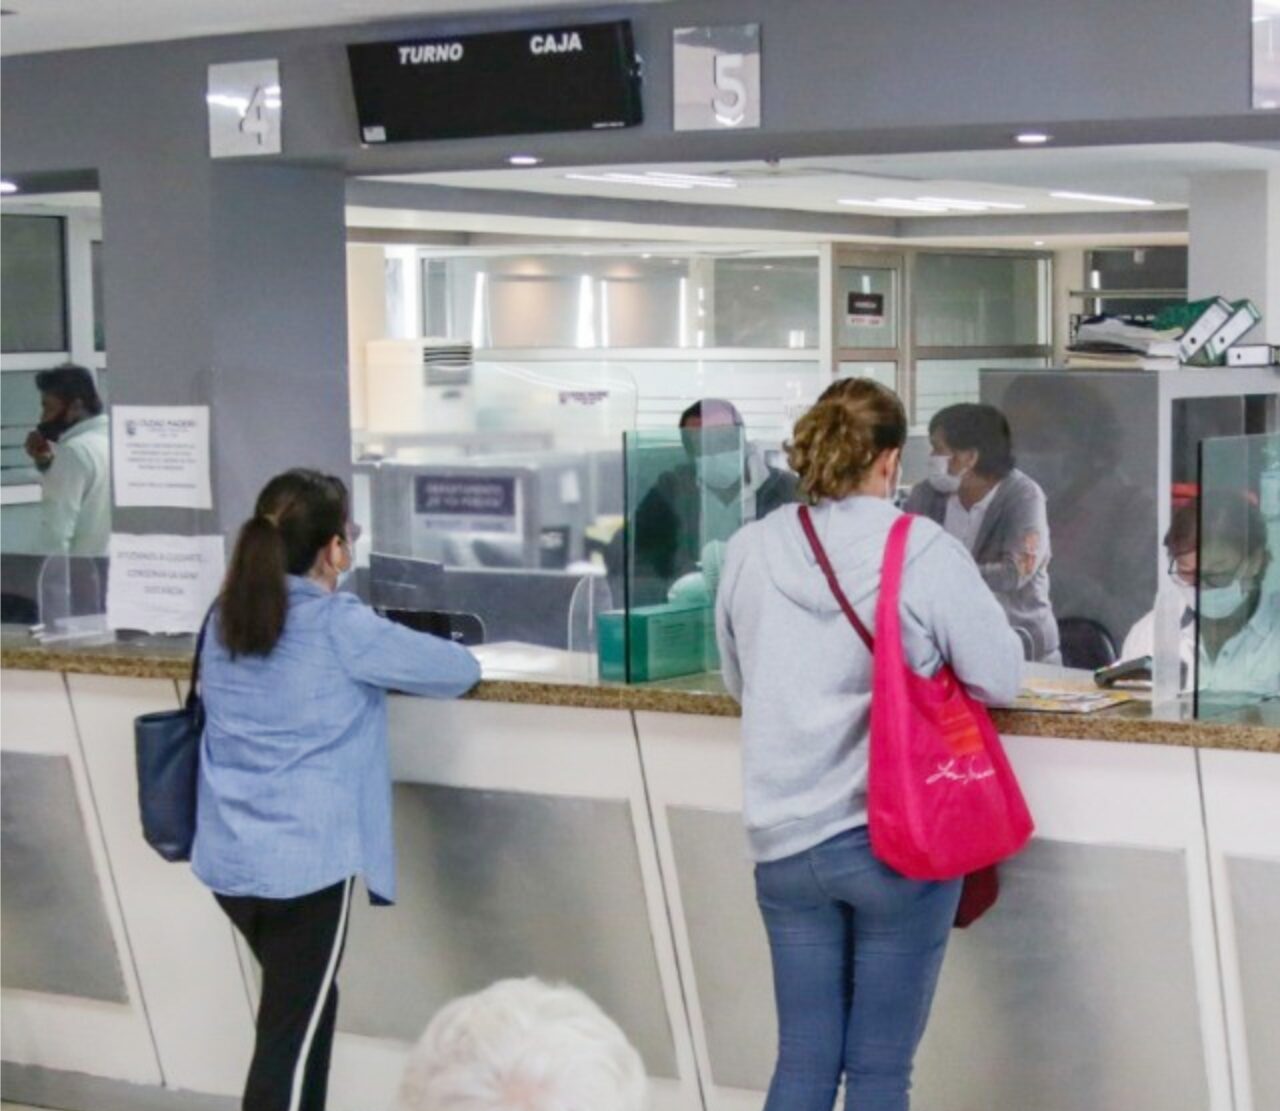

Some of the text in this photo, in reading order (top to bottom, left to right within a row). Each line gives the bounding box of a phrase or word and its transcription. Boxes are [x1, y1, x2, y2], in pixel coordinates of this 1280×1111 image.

[398, 31, 583, 64] TURNO CAJA
[238, 84, 272, 148] 4
[712, 53, 747, 126] 5
